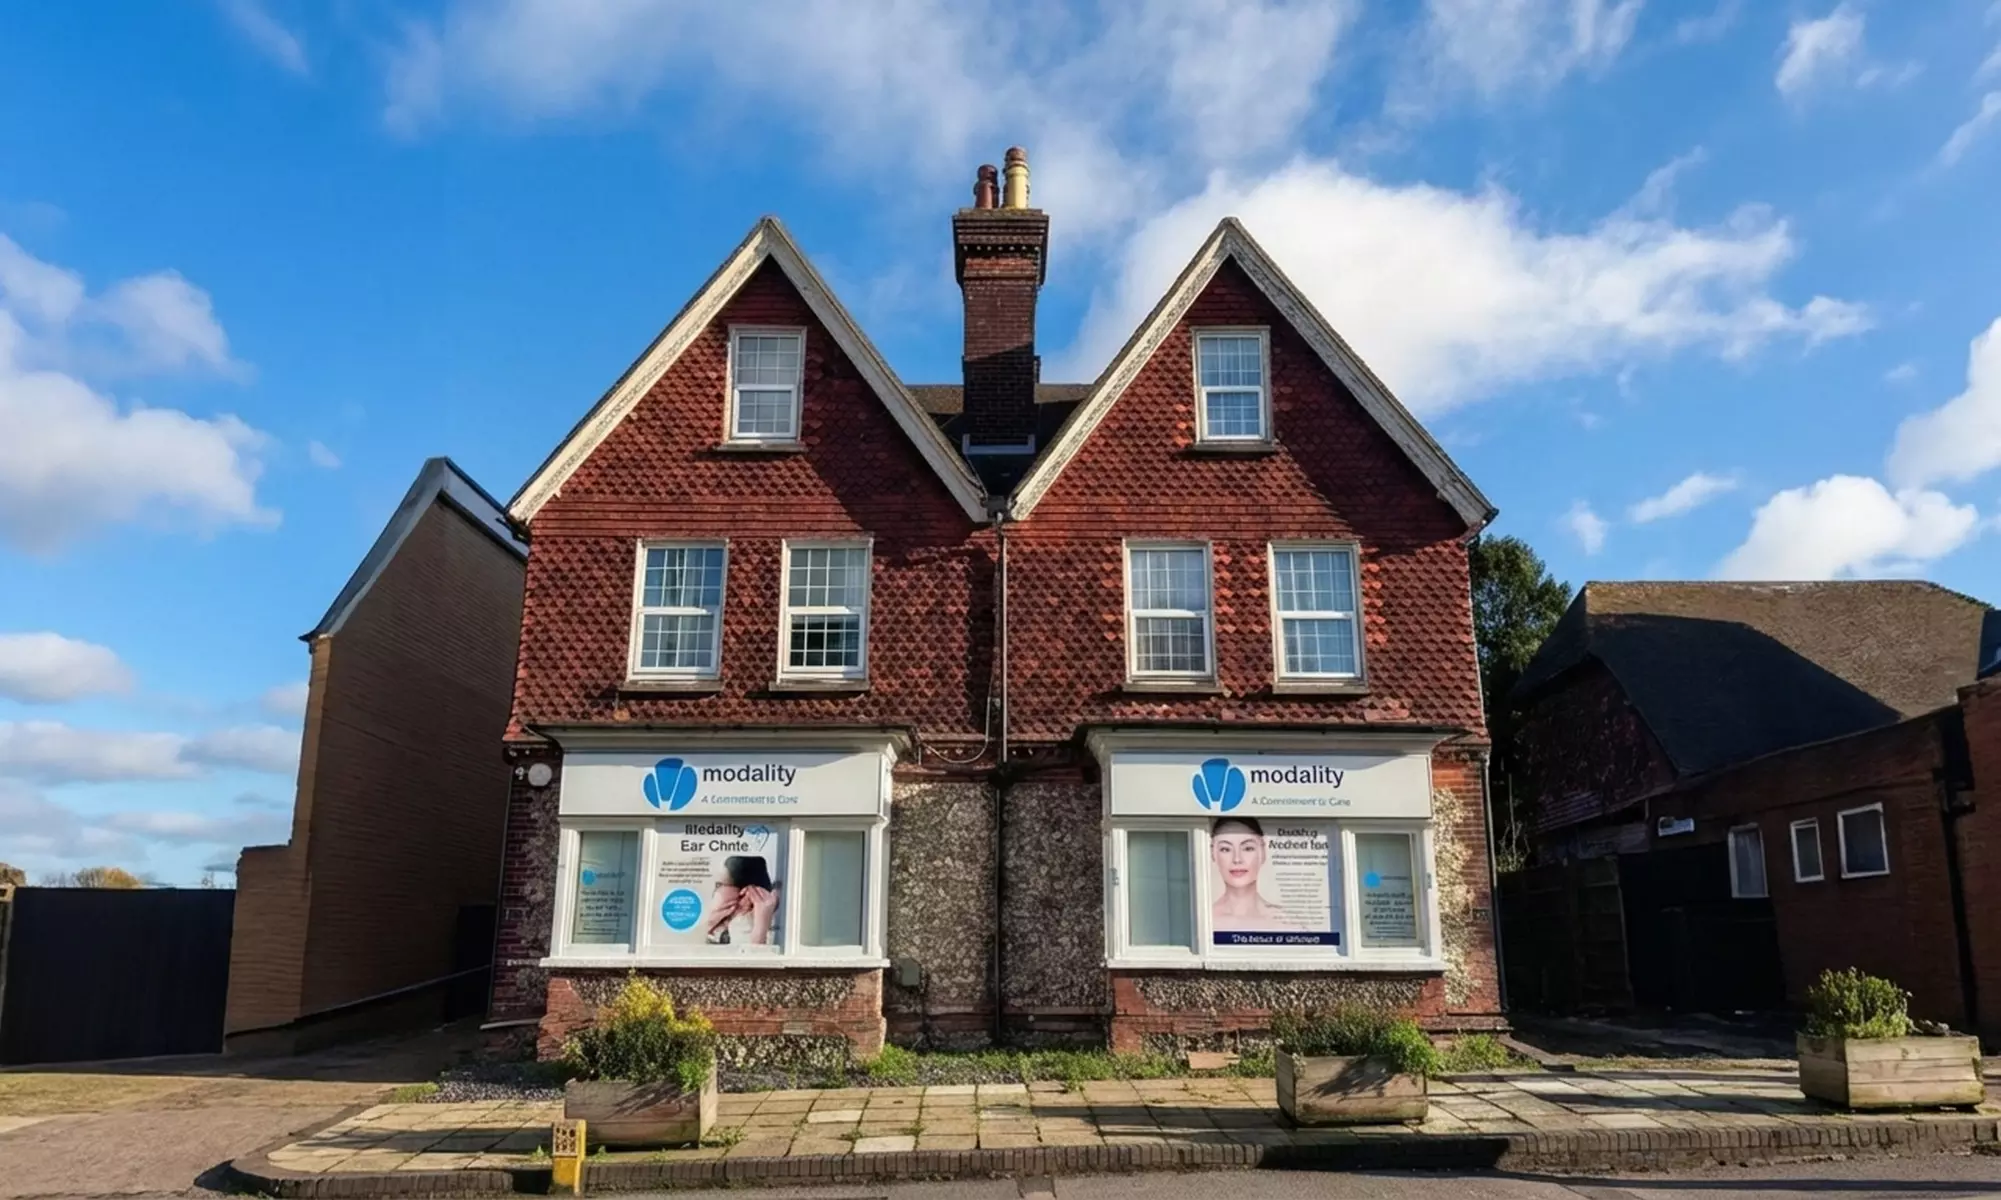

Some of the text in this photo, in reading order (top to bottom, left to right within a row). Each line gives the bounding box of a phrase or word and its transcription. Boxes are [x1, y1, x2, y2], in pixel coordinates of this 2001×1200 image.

[703, 764, 796, 787] modality
[1250, 765, 1344, 788] modality
[1252, 796, 1259, 805] A
[681, 840, 706, 852] Ear
